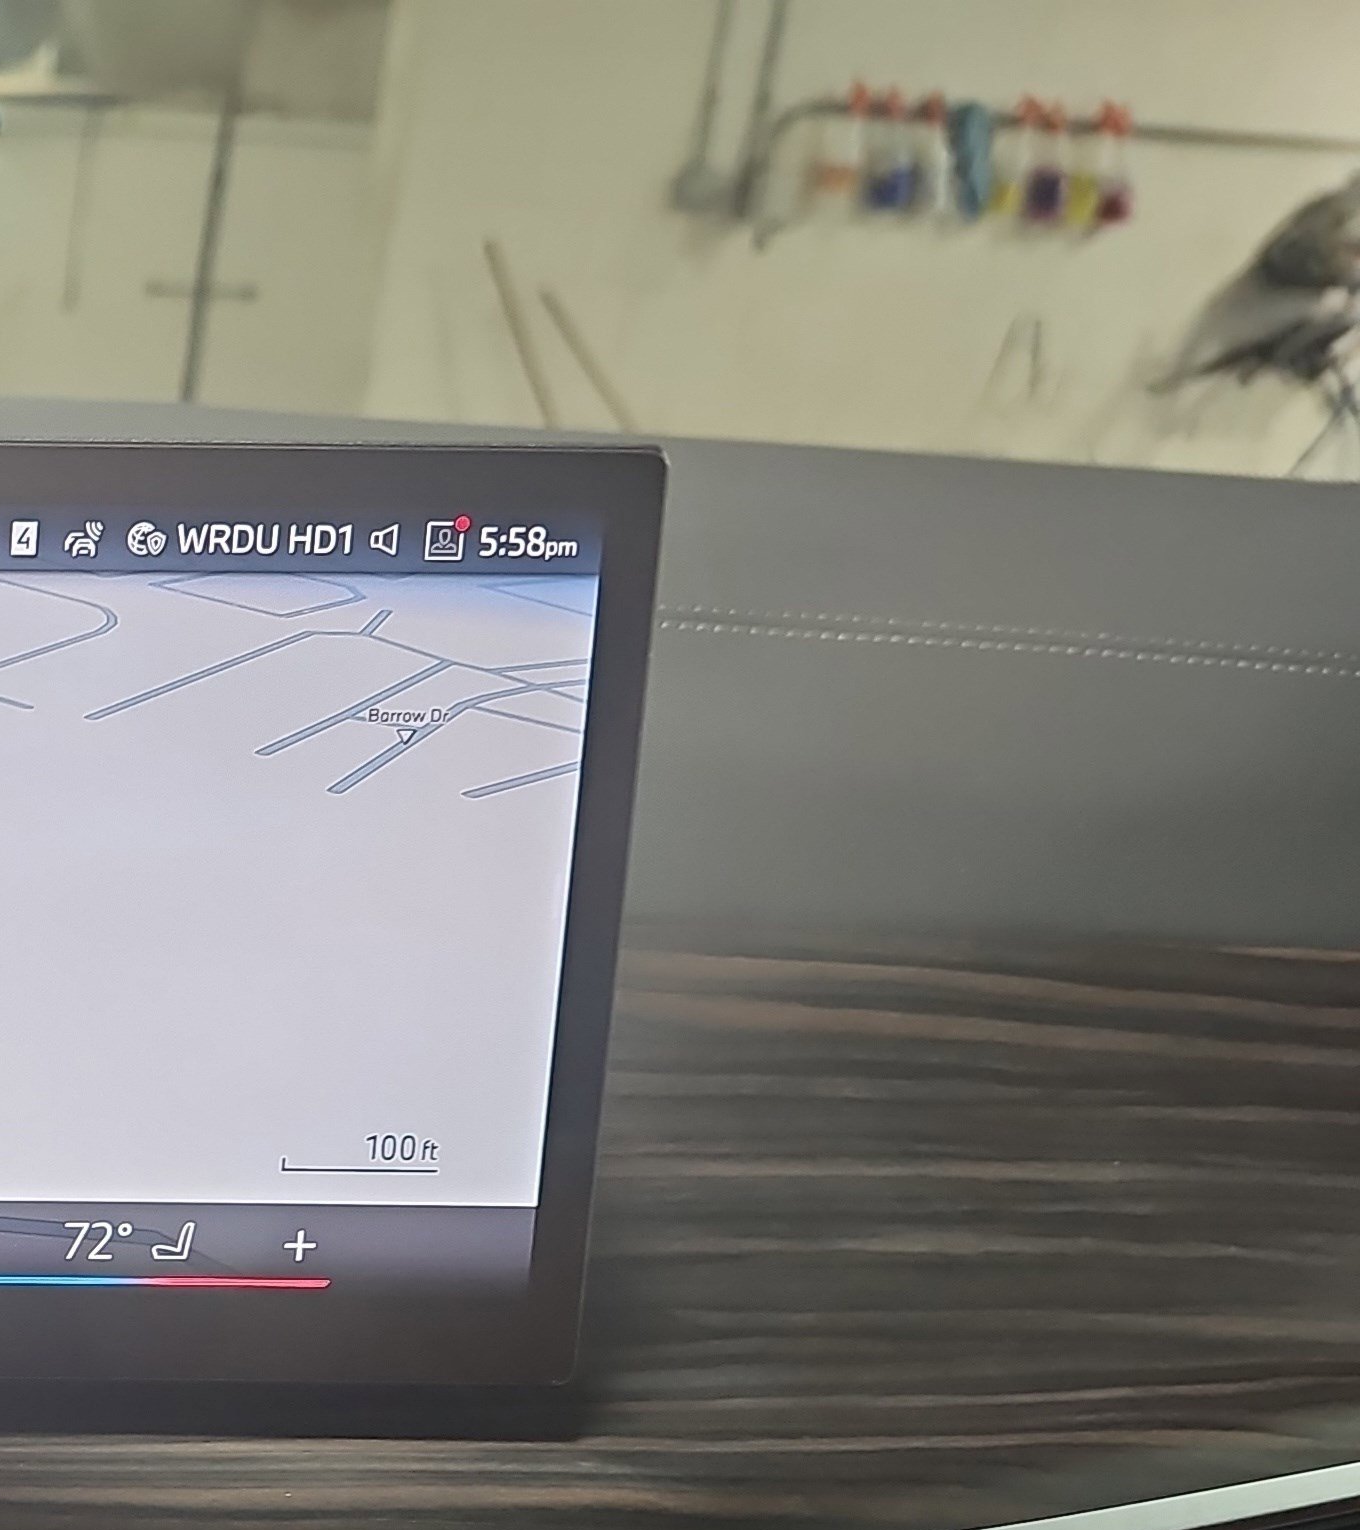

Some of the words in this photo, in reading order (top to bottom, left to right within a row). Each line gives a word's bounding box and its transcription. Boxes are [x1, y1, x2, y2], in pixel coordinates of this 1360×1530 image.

[179, 524, 279, 556] WRDU
[288, 525, 353, 556] HD1
[479, 527, 577, 559] 5:58pm
[368, 708, 426, 723] Barrow
[430, 708, 449, 723] Dr
[366, 1135, 417, 1161] 100
[422, 1139, 438, 1160] ft
[65, 1222, 133, 1260] 72°
